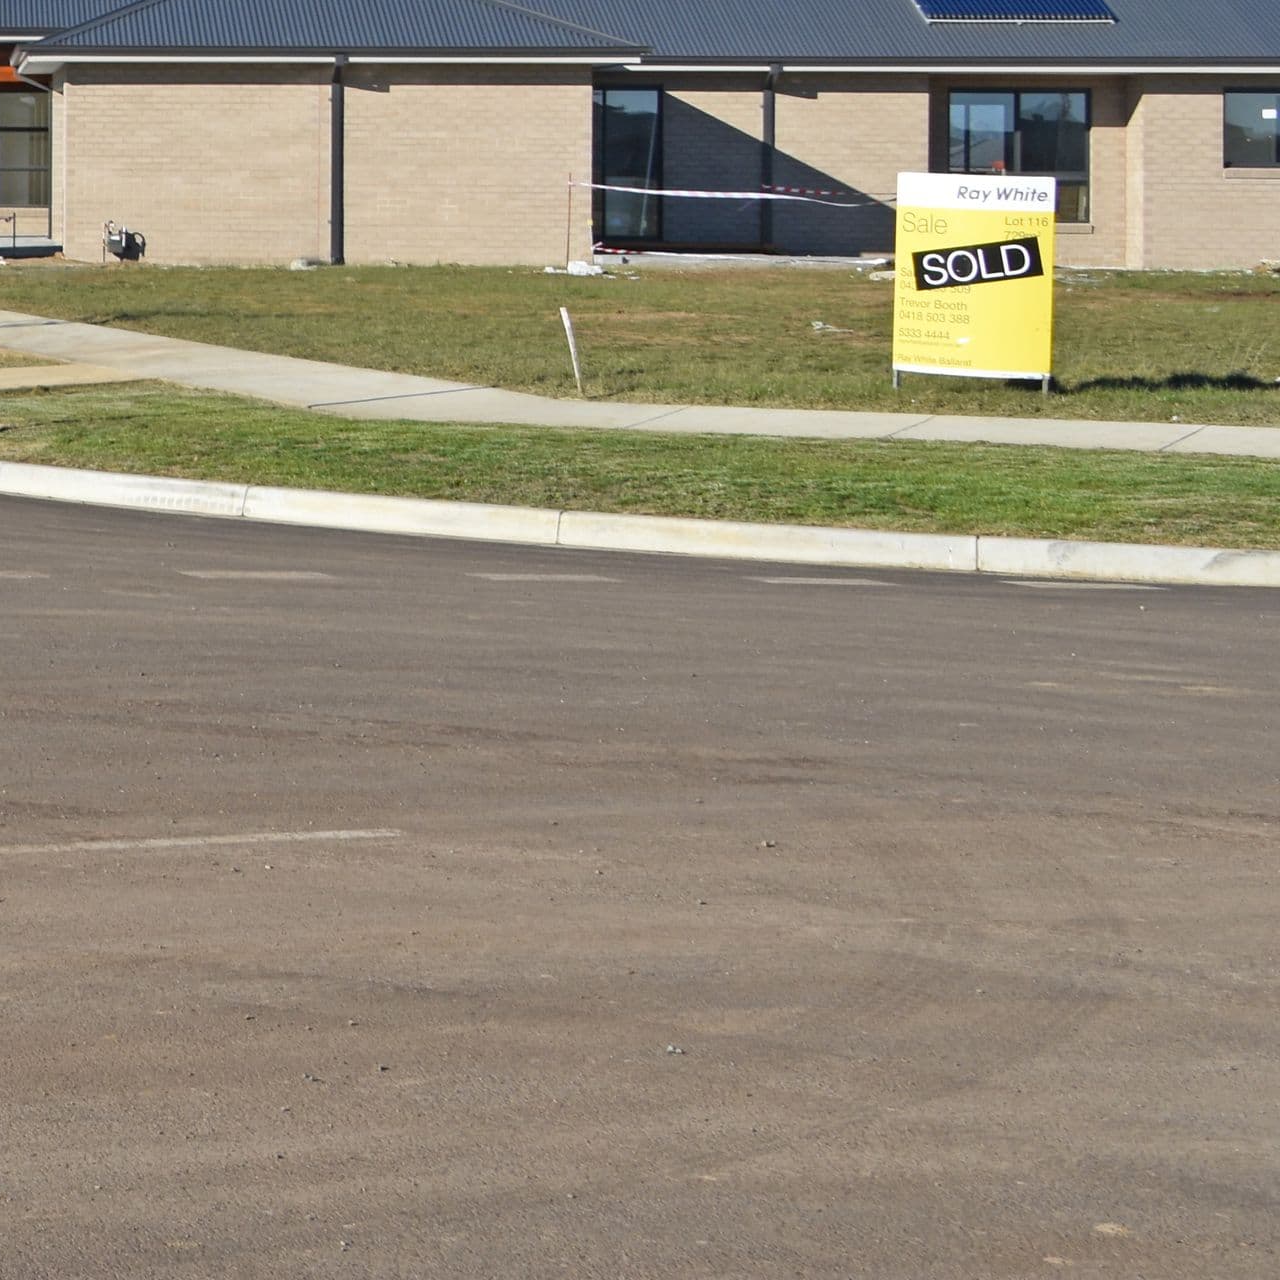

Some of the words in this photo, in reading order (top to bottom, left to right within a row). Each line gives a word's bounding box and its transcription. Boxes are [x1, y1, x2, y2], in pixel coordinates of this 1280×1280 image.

[957, 185, 991, 202] Ray
[996, 187, 1048, 202] White
[902, 211, 948, 235] Sale
[1005, 216, 1023, 226] Lot
[1028, 217, 1049, 227] 116
[922, 244, 1031, 286] SOLD
[900, 296, 931, 308] Trevor
[934, 299, 968, 311] Booth
